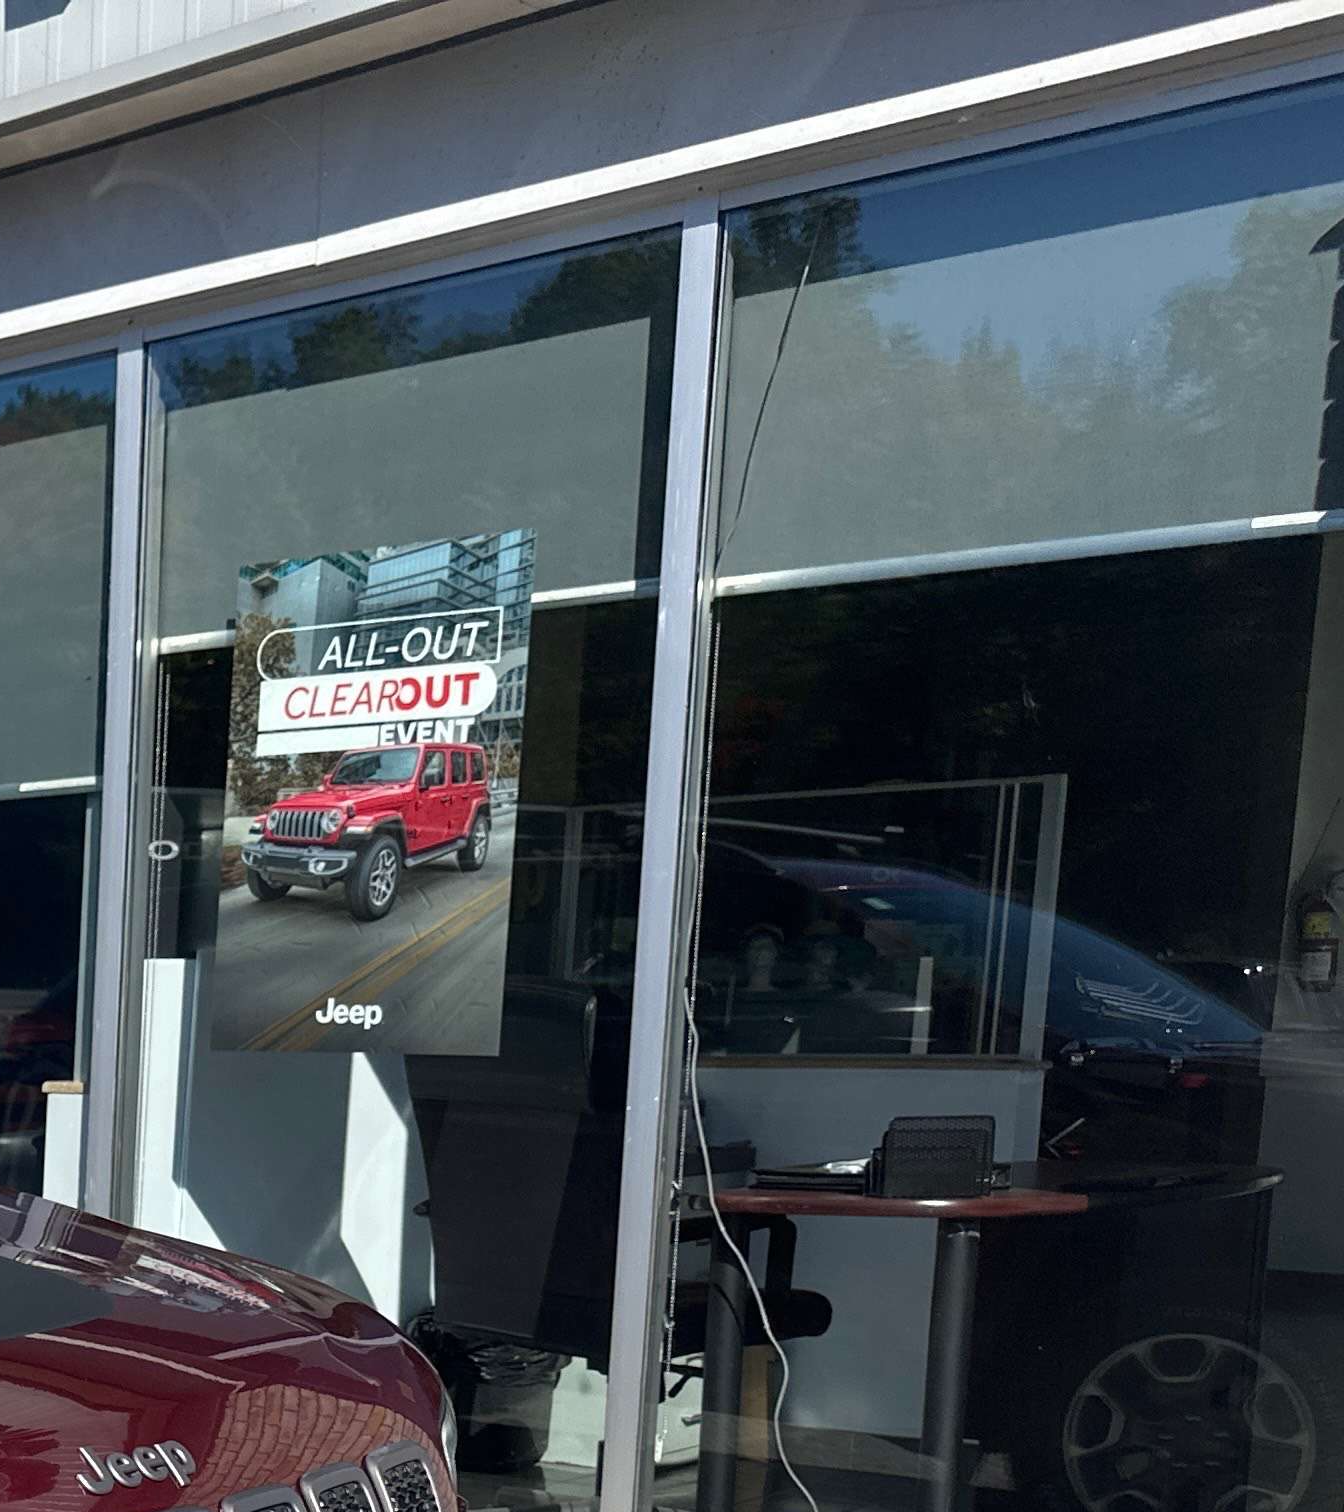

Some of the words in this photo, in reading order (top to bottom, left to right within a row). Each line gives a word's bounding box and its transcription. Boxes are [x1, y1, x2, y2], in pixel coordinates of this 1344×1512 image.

[317, 620, 490, 671] ALL-OUT
[283, 671, 481, 721] CLEAROUT
[379, 717, 476, 748] EVENT
[314, 997, 385, 1030] Jeep
[75, 1436, 197, 1495] Jeep
